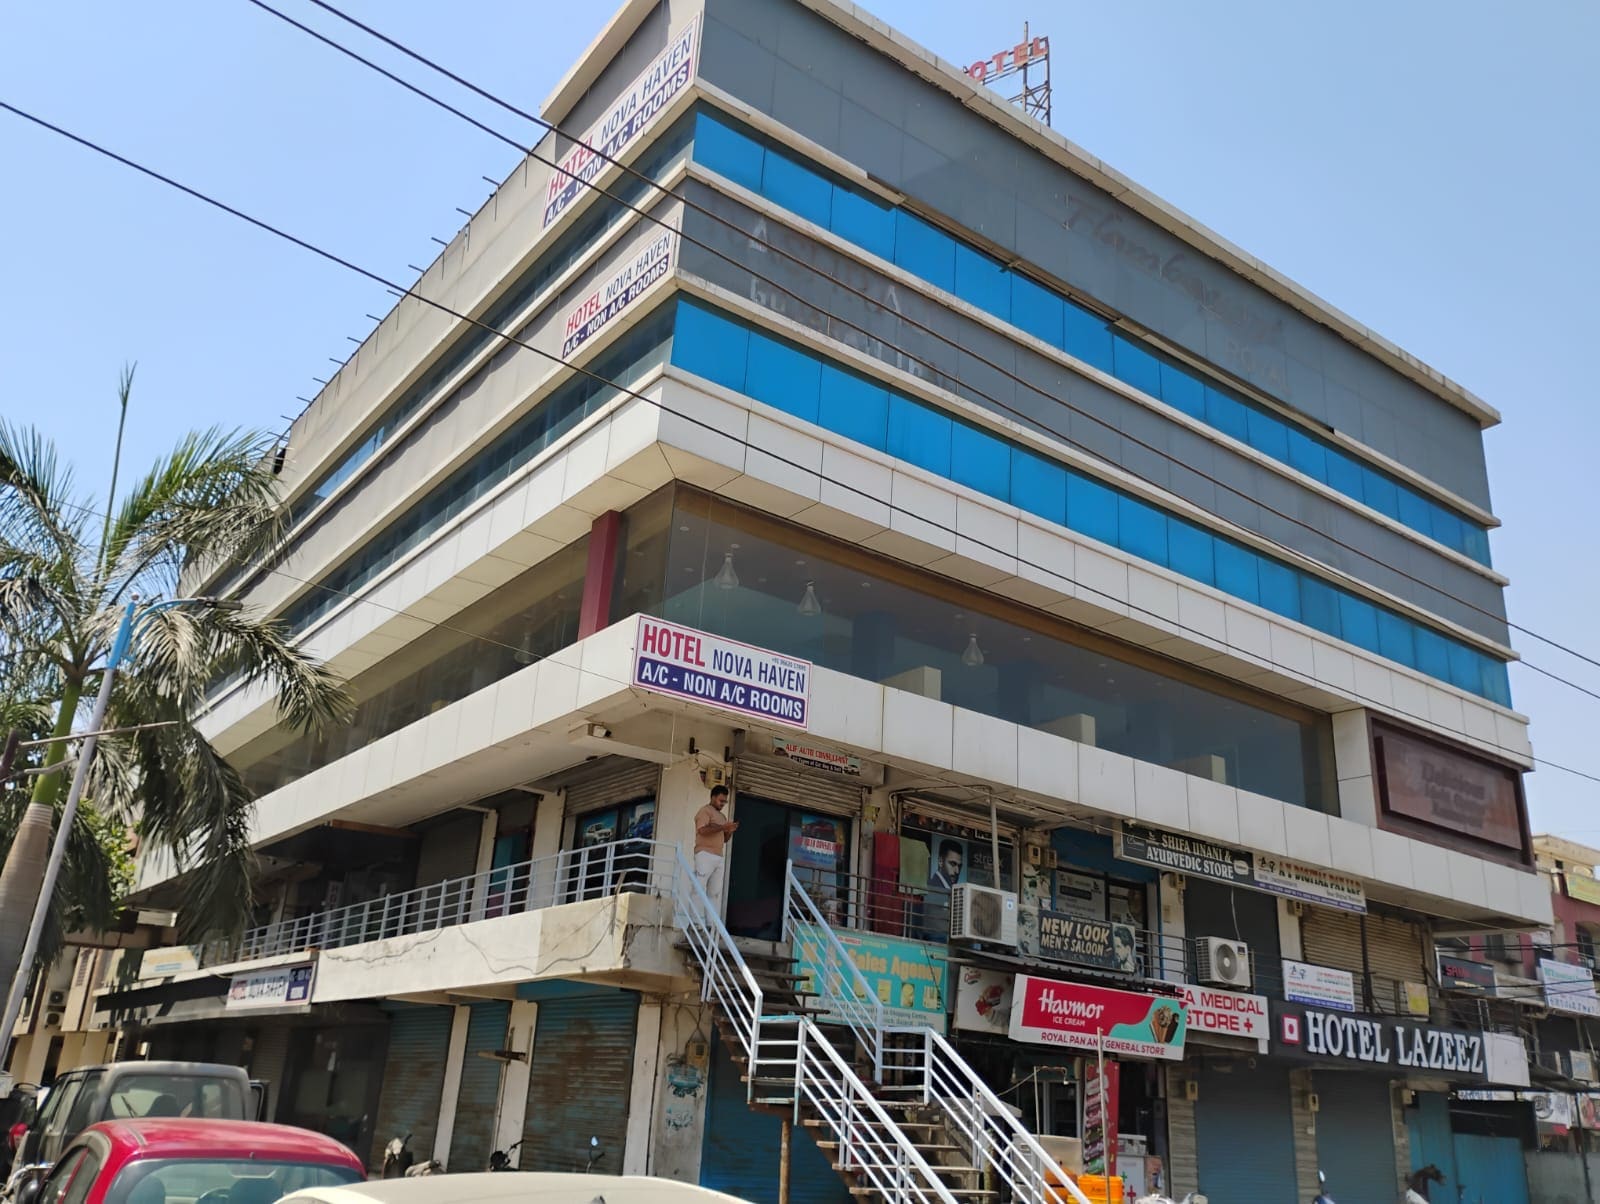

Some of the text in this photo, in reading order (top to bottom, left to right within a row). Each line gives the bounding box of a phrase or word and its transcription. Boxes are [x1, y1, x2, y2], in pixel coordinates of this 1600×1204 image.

[968, 37, 1047, 81] OTEL
[548, 134, 595, 200] HOTEL
[600, 92, 637, 145] NOVA
[642, 32, 691, 100] HAVEN
[545, 194, 565, 227] A/C
[575, 160, 601, 193] NON
[606, 126, 629, 156] A/C
[631, 65, 688, 131] ROOMS
[567, 233, 670, 336] HOTEL NOVA HAVEN
[564, 334, 580, 356] A/C
[587, 312, 607, 336] NON
[609, 293, 626, 317] A/C
[628, 260, 668, 301] ROOMS
[642, 623, 805, 693] HOTEL NOVA HAVEN
[641, 662, 669, 685] A/C
[683, 672, 716, 698] NON
[720, 682, 745, 705] A/C
[750, 690, 802, 720] ROOMS
[799, 746, 814, 757] AUTO
[1146, 845, 1202, 872] AYURVEDIC
[1203, 860, 1234, 880] STORE
[1161, 833, 1192, 854] SHIFA
[1224, 851, 1233, 863] &
[1041, 916, 1074, 937] NEW
[1076, 924, 1110, 945] LOOK
[1041, 933, 1104, 957] MEN'S SALOON
[848, 948, 886, 974] Sales
[891, 956, 943, 986] Agency
[1038, 988, 1105, 1019] Havmor
[1052, 1016, 1086, 1026] ICE CREAM
[1200, 992, 1264, 1016] MEDICAL
[1041, 1032, 1068, 1044] ROYAL
[1069, 1036, 1086, 1046] PAN
[1105, 1041, 1140, 1053] GENERAL
[1141, 1045, 1165, 1056] STORE
[1305, 1010, 1484, 1074] HOTEL LAZEEZ
